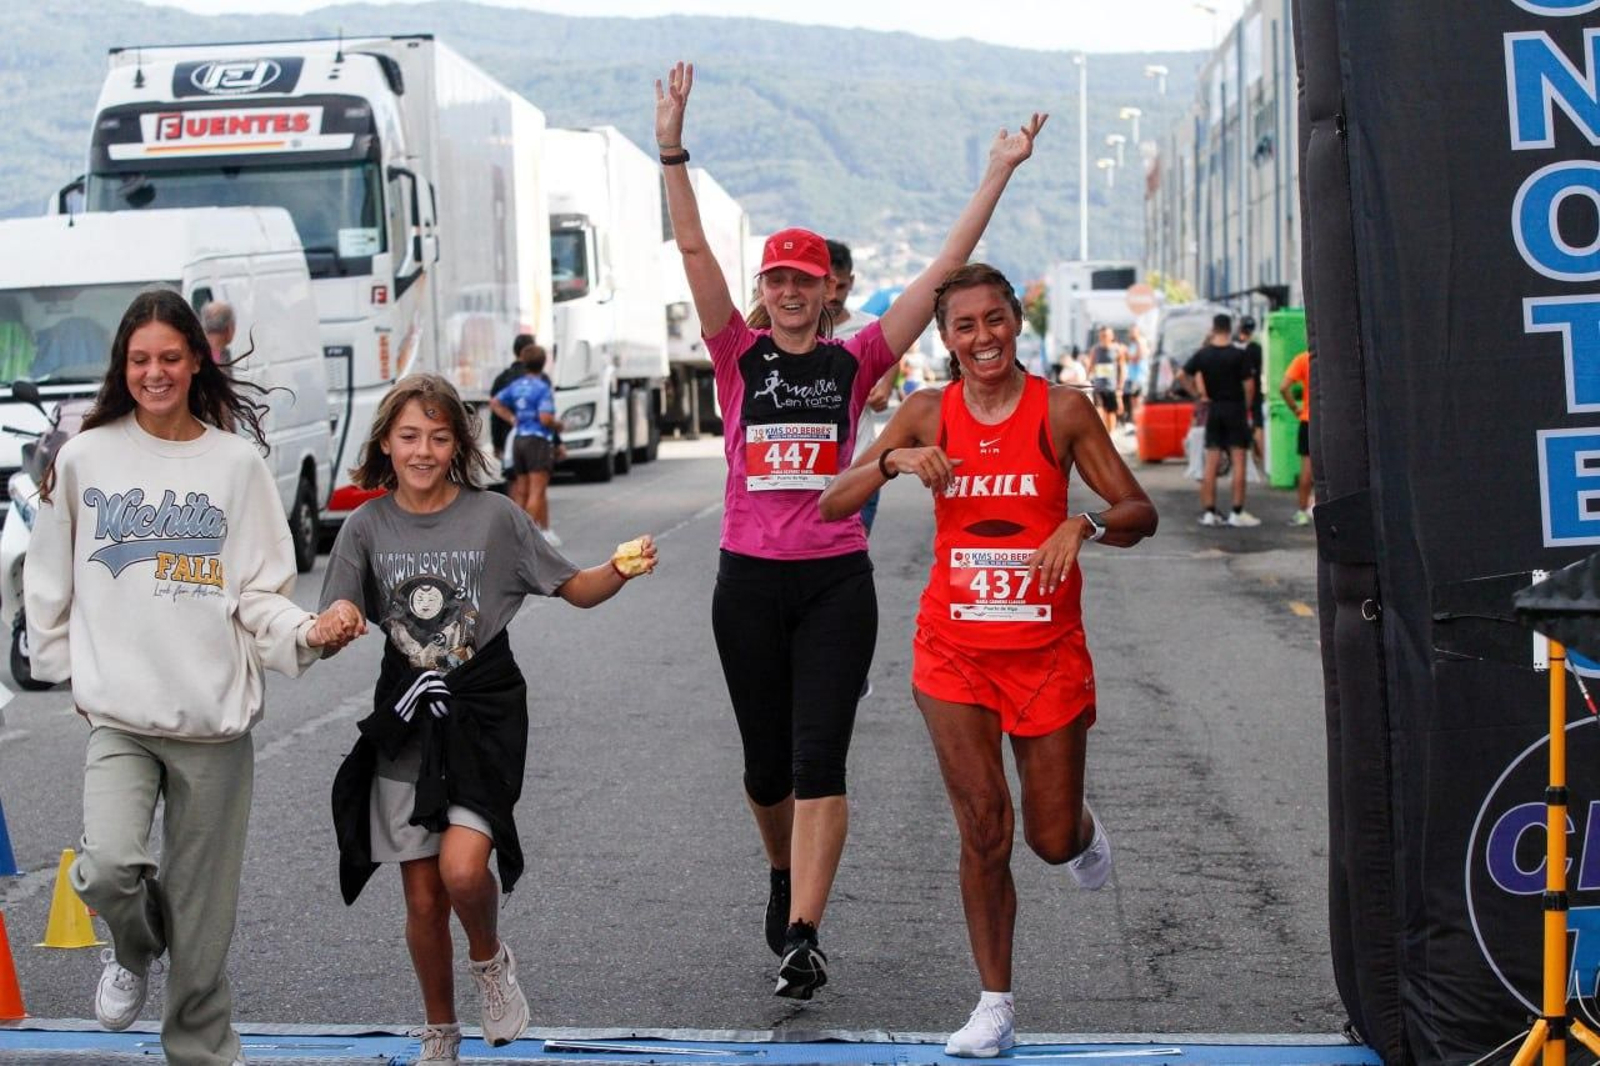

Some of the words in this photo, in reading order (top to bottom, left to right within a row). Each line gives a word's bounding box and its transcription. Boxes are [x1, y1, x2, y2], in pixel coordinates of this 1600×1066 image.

[765, 443, 820, 469] 447
[83, 487, 227, 543] Wichita
[970, 570, 1032, 599] 437
